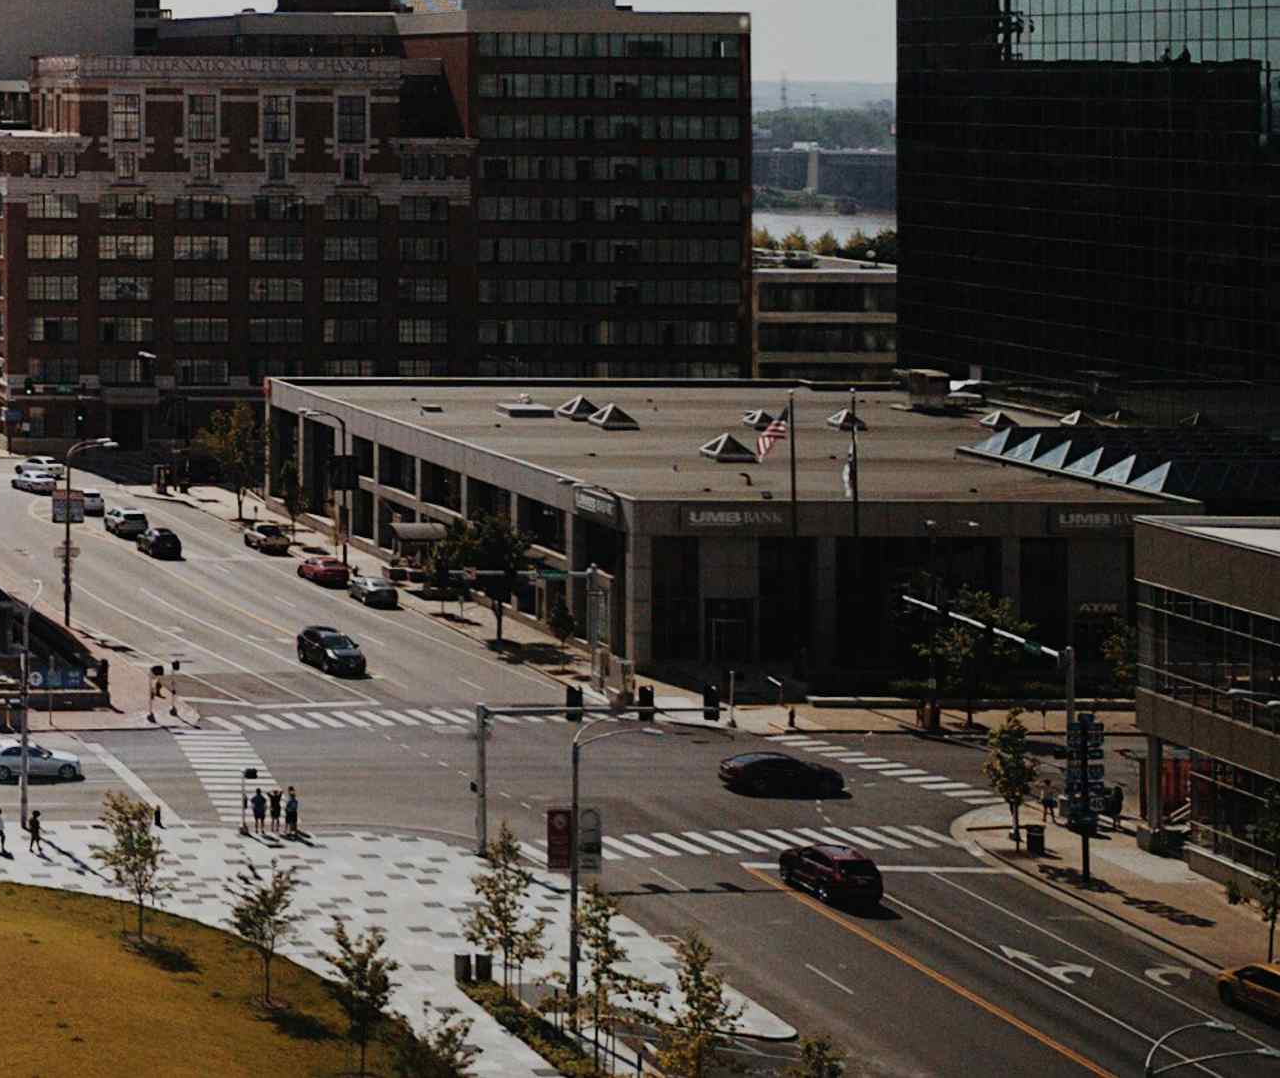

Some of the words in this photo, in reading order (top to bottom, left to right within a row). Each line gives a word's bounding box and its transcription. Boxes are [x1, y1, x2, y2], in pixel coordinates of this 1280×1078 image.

[688, 511, 741, 523] UMB
[744, 512, 782, 523] BANK
[1058, 513, 1112, 524] UMB
[1079, 602, 1119, 612] ATM
